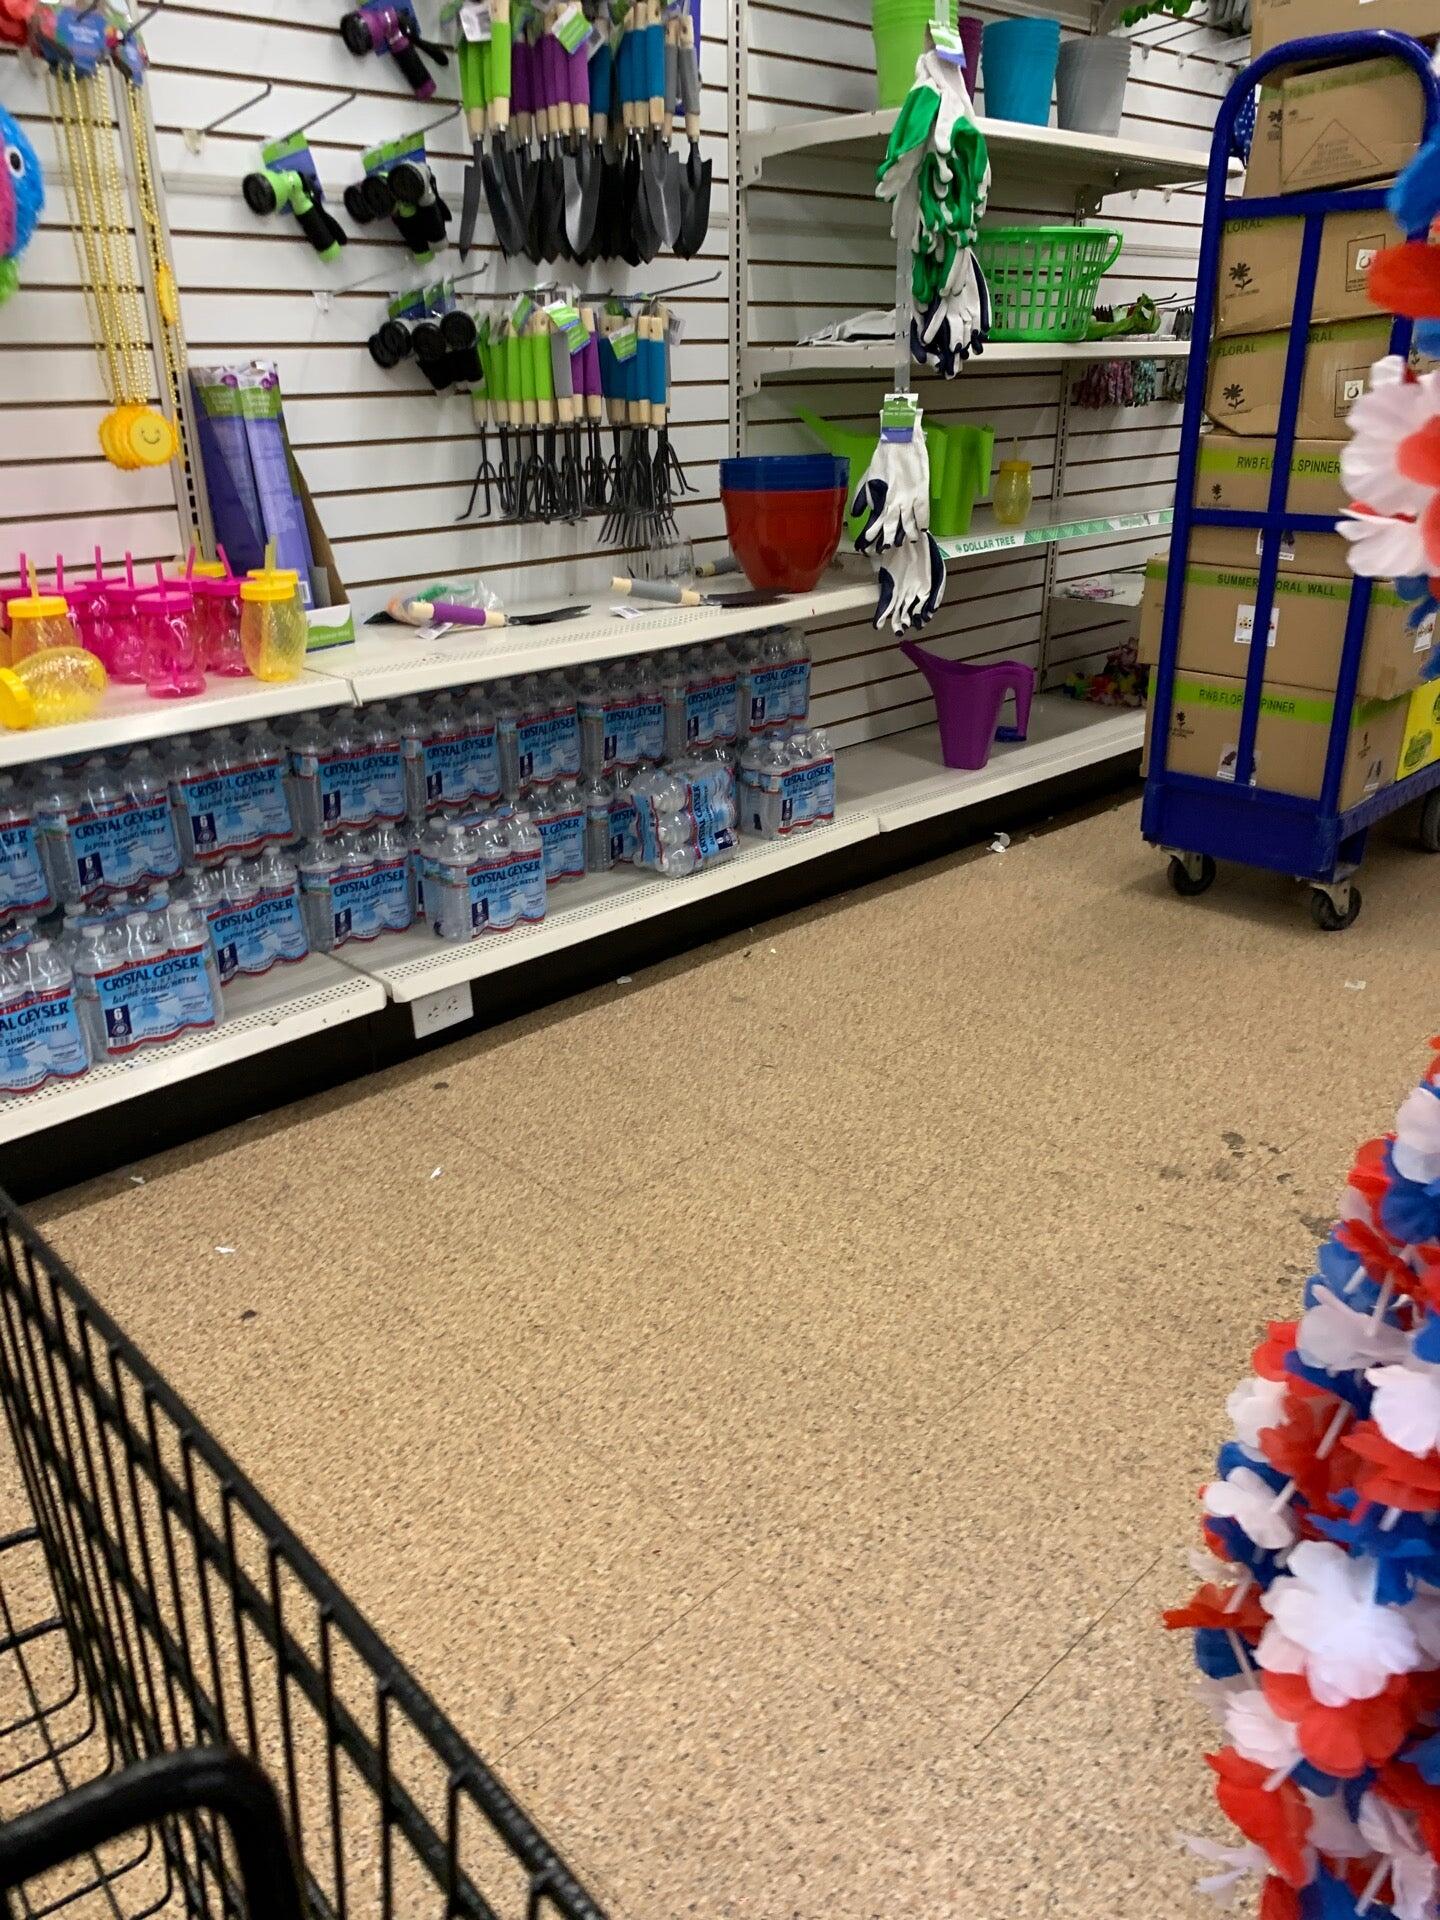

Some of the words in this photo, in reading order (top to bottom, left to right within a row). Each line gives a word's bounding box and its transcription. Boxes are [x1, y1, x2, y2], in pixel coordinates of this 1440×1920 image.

[1226, 219, 1264, 233] LORAL
[1237, 456, 1257, 469] RWB
[1298, 459, 1342, 474] SPINNER
[963, 539, 994, 552] DOLLAR
[995, 535, 1016, 547] TREE
[1217, 573, 1259, 588] SUMMER
[1308, 583, 1336, 596] WALL
[1260, 698, 1296, 713] PINNER
[75, 818, 121, 840] CRYSTAL
[123, 806, 167, 826] GEYSER
[85, 857, 93, 869] 6
[471, 871, 508, 887] CRYSTAL
[508, 860, 541, 879] GEYSER
[214, 911, 255, 932] CRYSTAL
[255, 898, 294, 918] GEYSER
[103, 968, 151, 992] CRYSTAL
[153, 956, 200, 978] GEYSER
[18, 1000, 70, 1026] GEYSER
[113, 1008, 123, 1020] 6
[5, 1030, 37, 1047] SPRING
[38, 1021, 68, 1035] WATER
